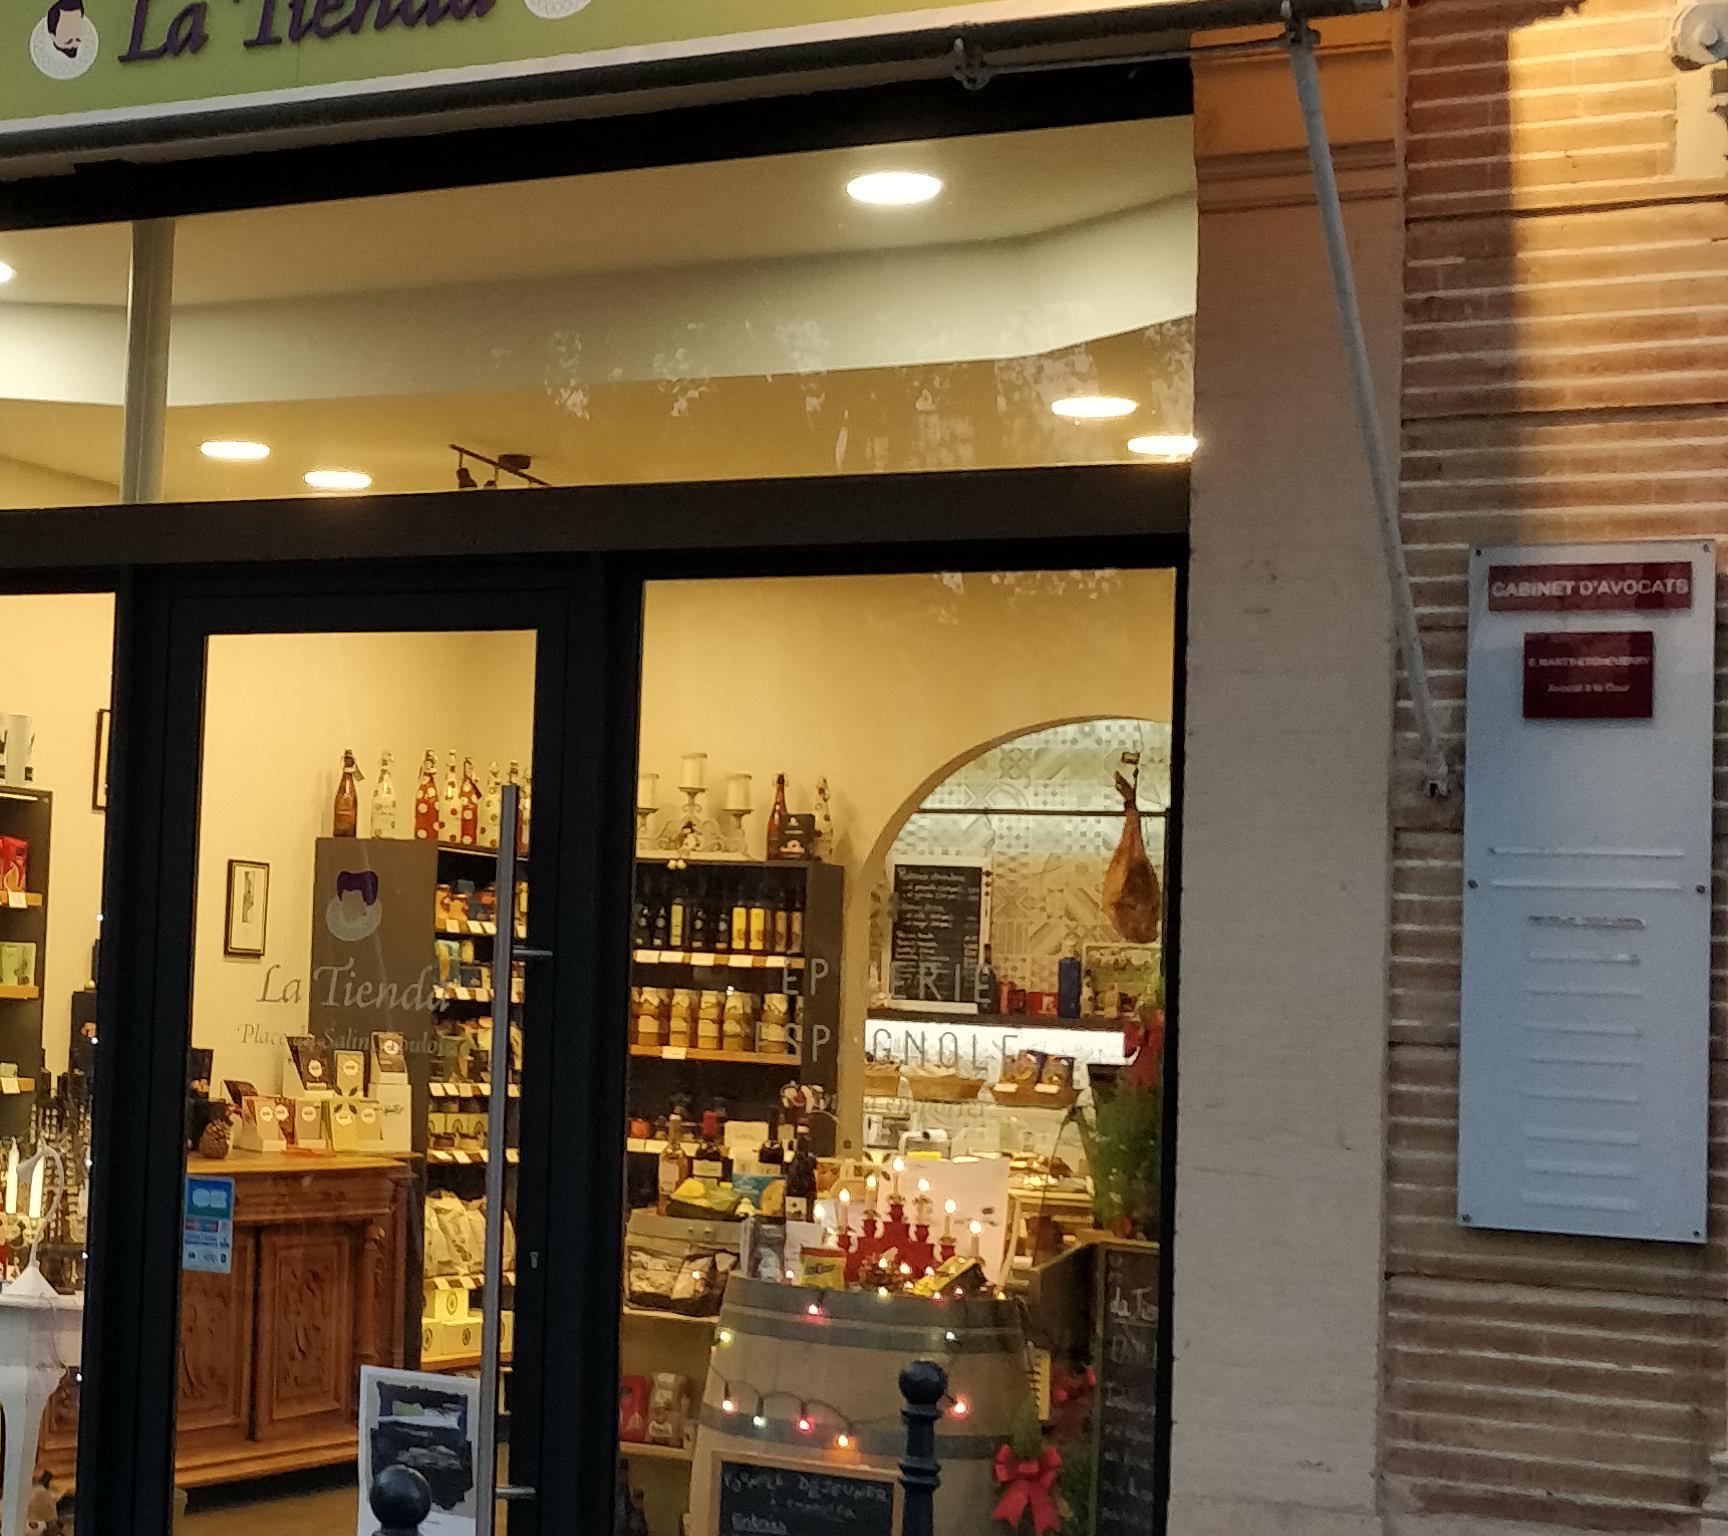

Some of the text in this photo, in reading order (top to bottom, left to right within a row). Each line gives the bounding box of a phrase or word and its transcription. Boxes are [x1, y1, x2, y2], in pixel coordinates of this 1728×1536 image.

[1491, 578, 1689, 597] CABINET D'AVOCATS
[255, 956, 451, 1012] La Tienda
